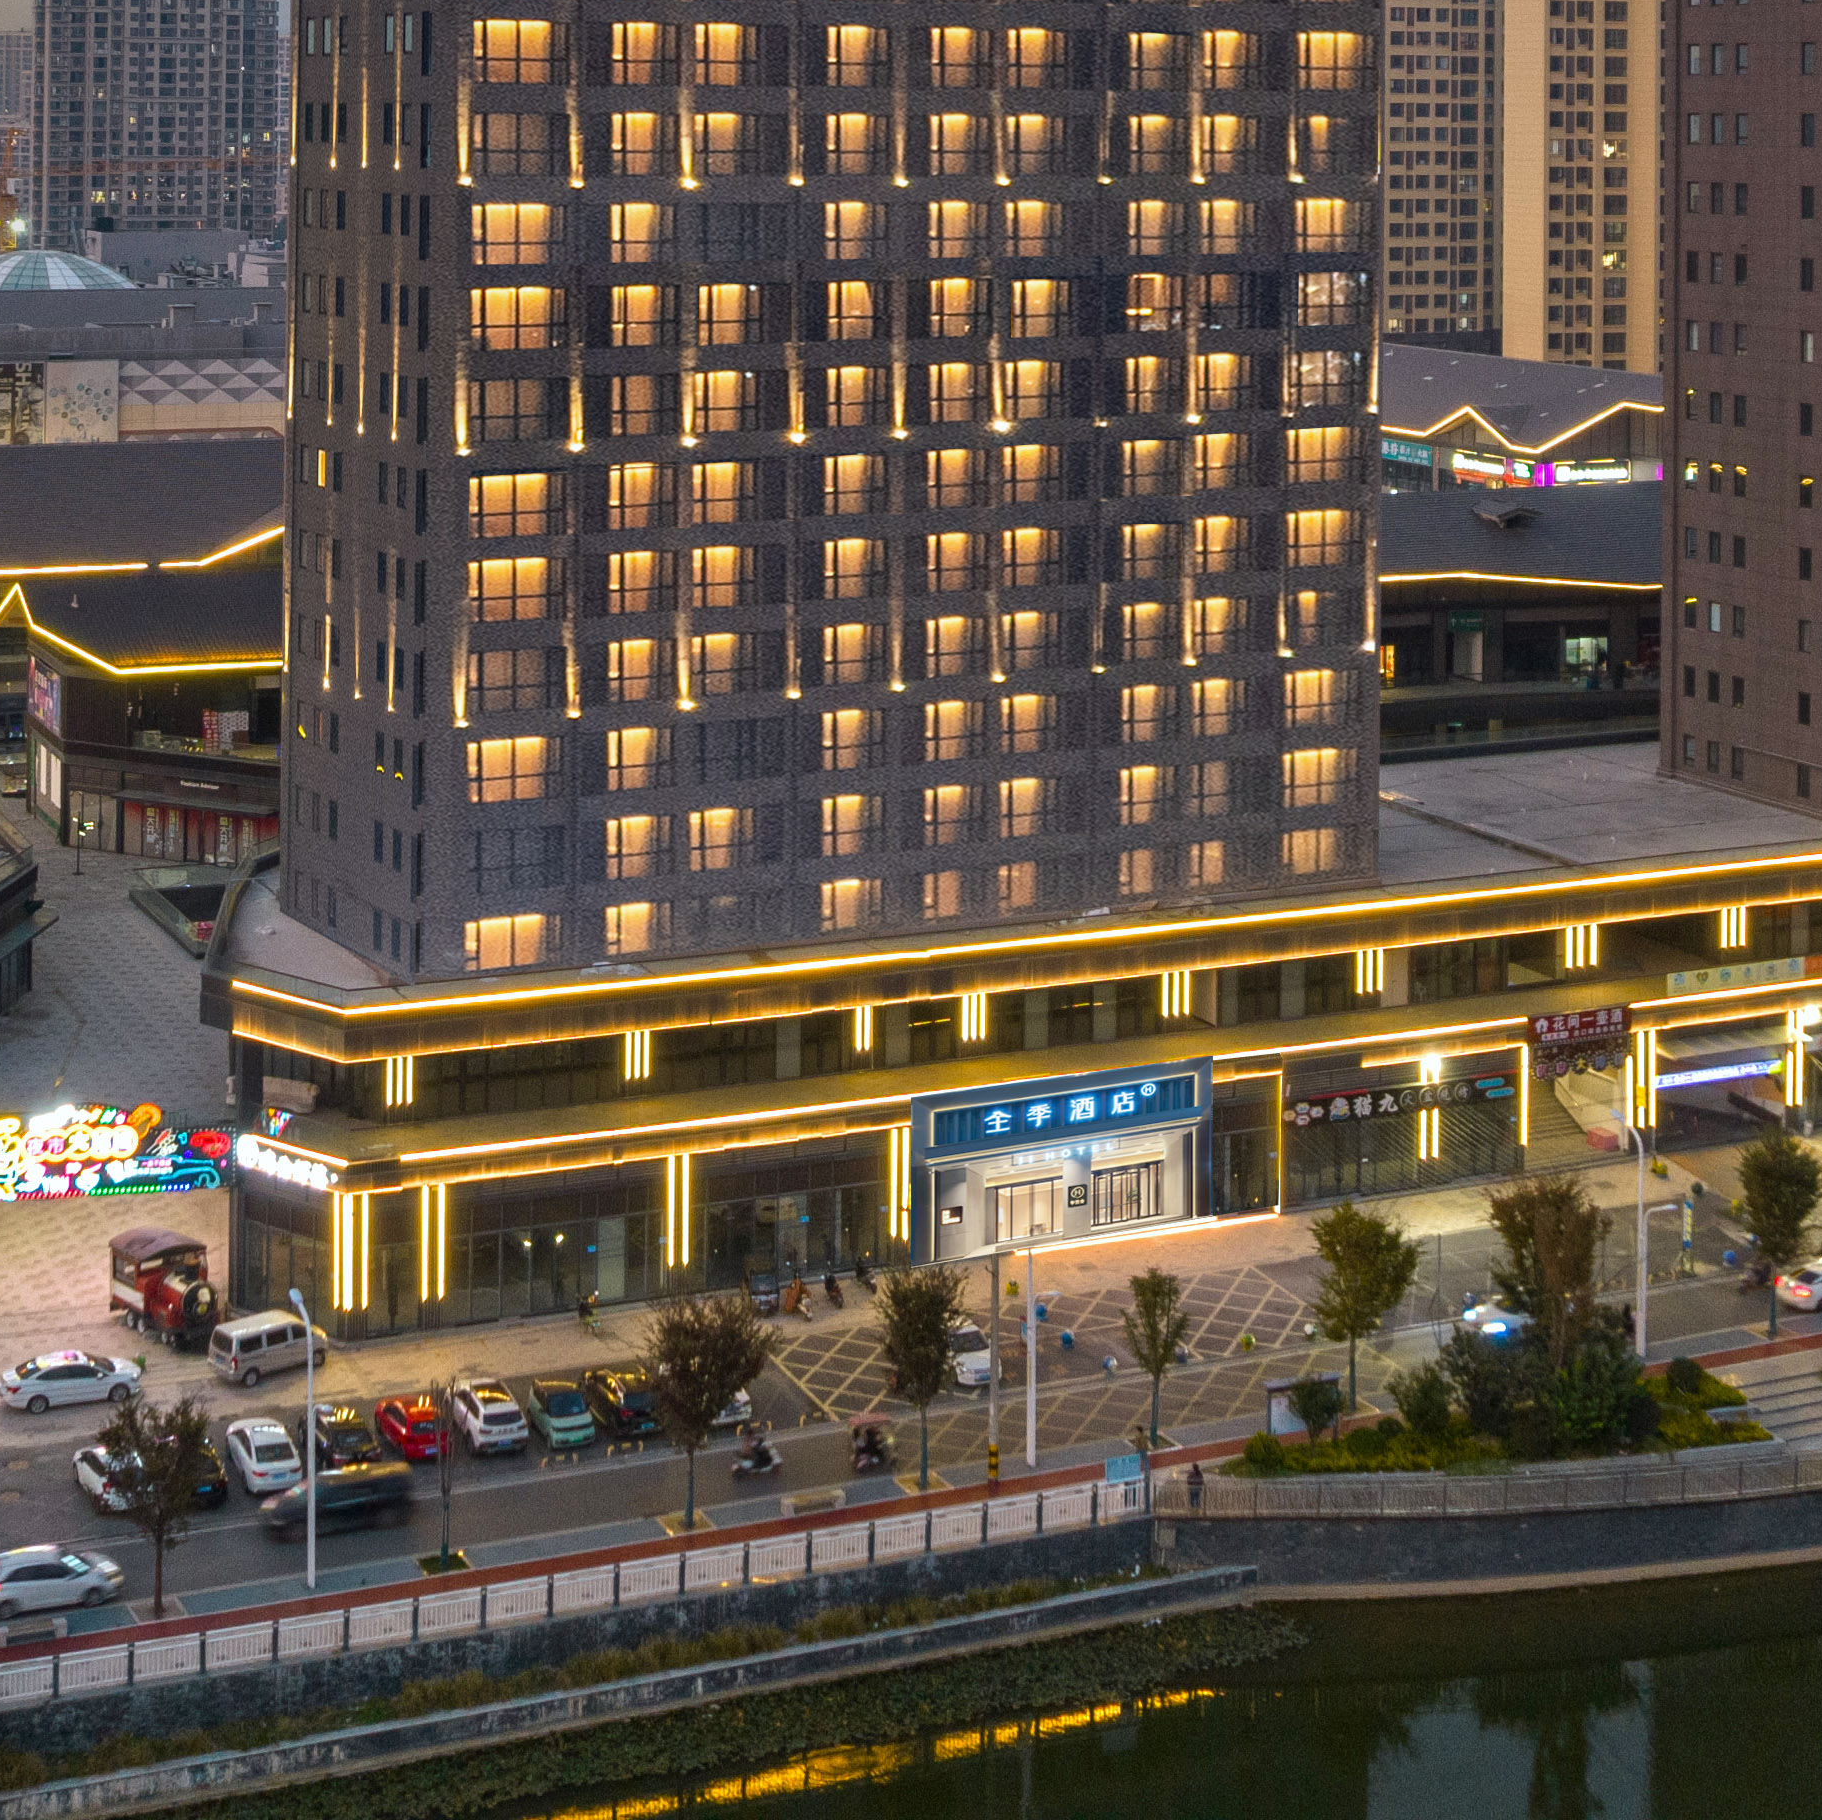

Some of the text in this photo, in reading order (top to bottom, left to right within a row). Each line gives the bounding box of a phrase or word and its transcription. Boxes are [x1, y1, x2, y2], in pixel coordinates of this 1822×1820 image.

[984, 1091, 1135, 1134] 全季酒店
[1045, 1141, 1115, 1162] HOTEL
